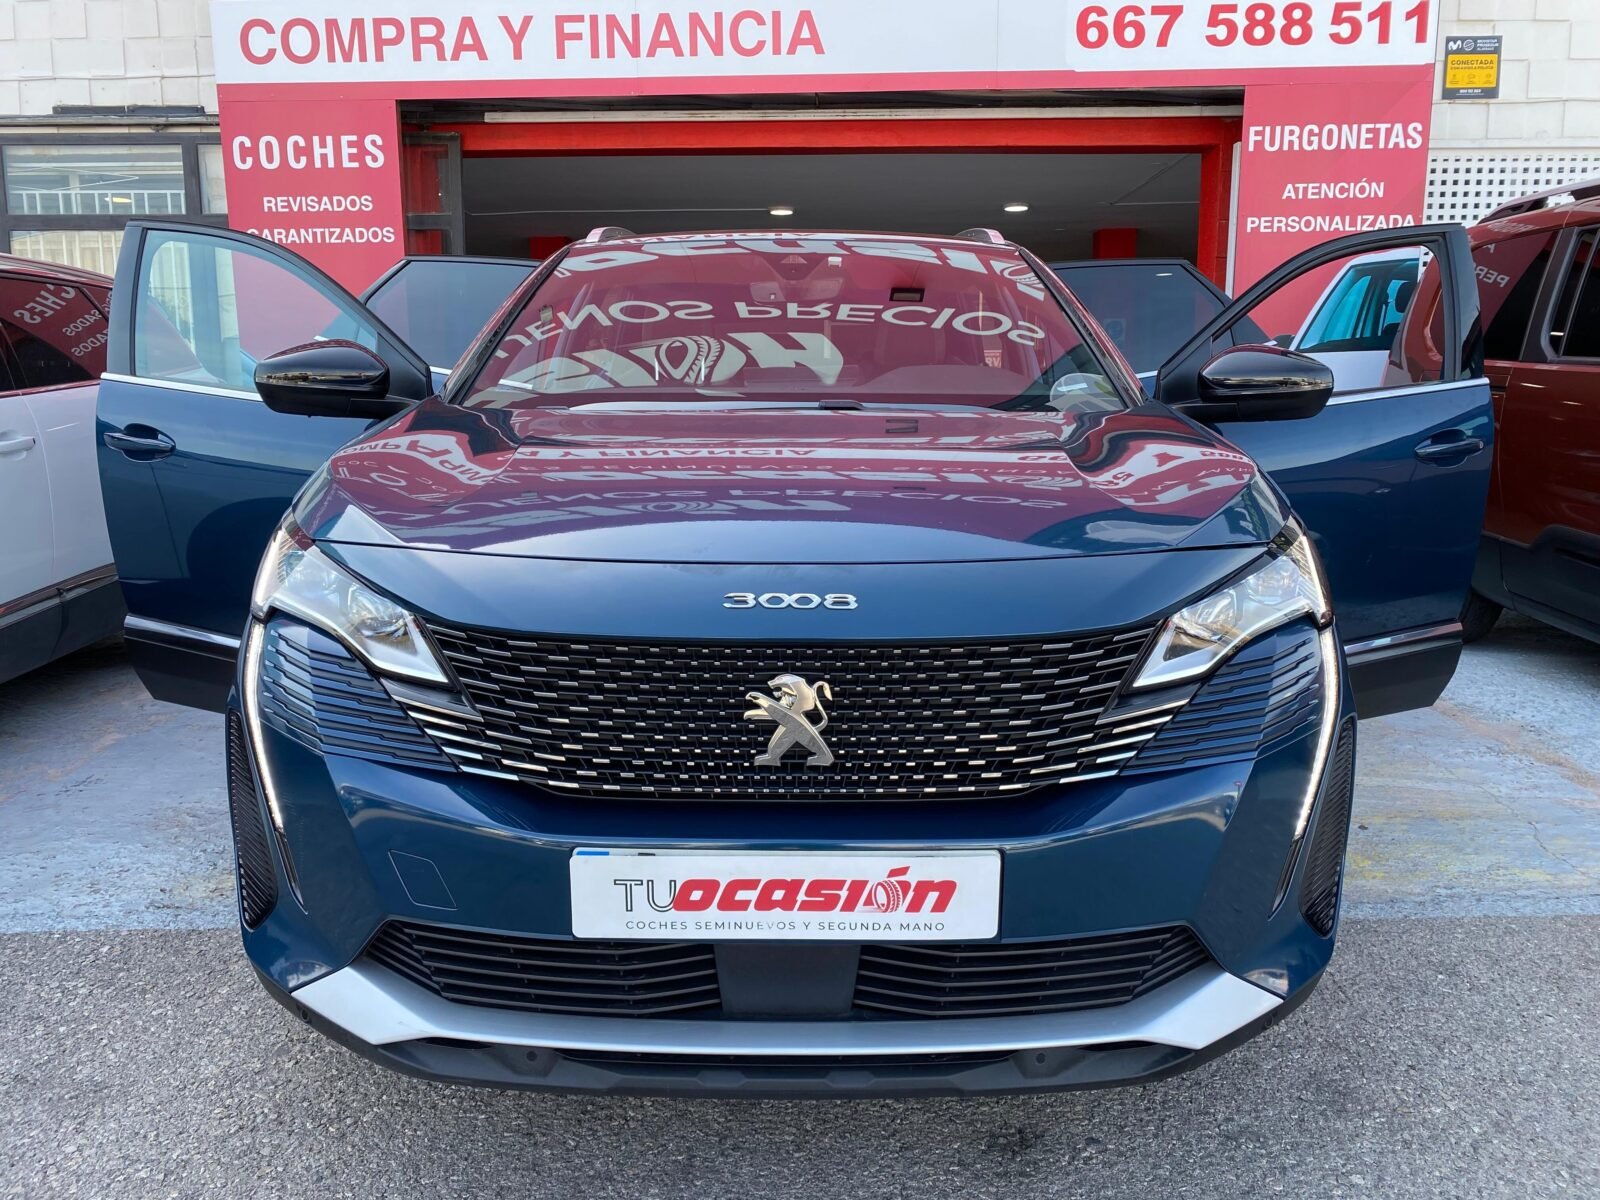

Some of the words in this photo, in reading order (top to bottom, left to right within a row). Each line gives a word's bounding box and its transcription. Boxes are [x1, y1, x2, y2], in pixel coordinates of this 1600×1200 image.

[1075, 4, 1184, 49] 667
[1205, 2, 1313, 47] 588
[1328, 0, 1430, 45] 511
[239, 15, 488, 65] COMPRA
[498, 14, 534, 62] Y
[555, 8, 825, 60] FINANCIA
[1247, 121, 1423, 152] FURGONETAS
[232, 134, 385, 170] COCHES
[1282, 178, 1385, 200] ATENCIÓN
[263, 195, 374, 213] REVISADOS
[1246, 214, 1415, 233] PERSONALIZADA
[722, 592, 859, 610] 3008
[625, 920, 688, 931] COCHES
[694, 920, 797, 931] SEMINUEVOS
[803, 921, 811, 931] Y
[818, 920, 893, 932] SEGUNDA
[899, 920, 946, 932] MANO
